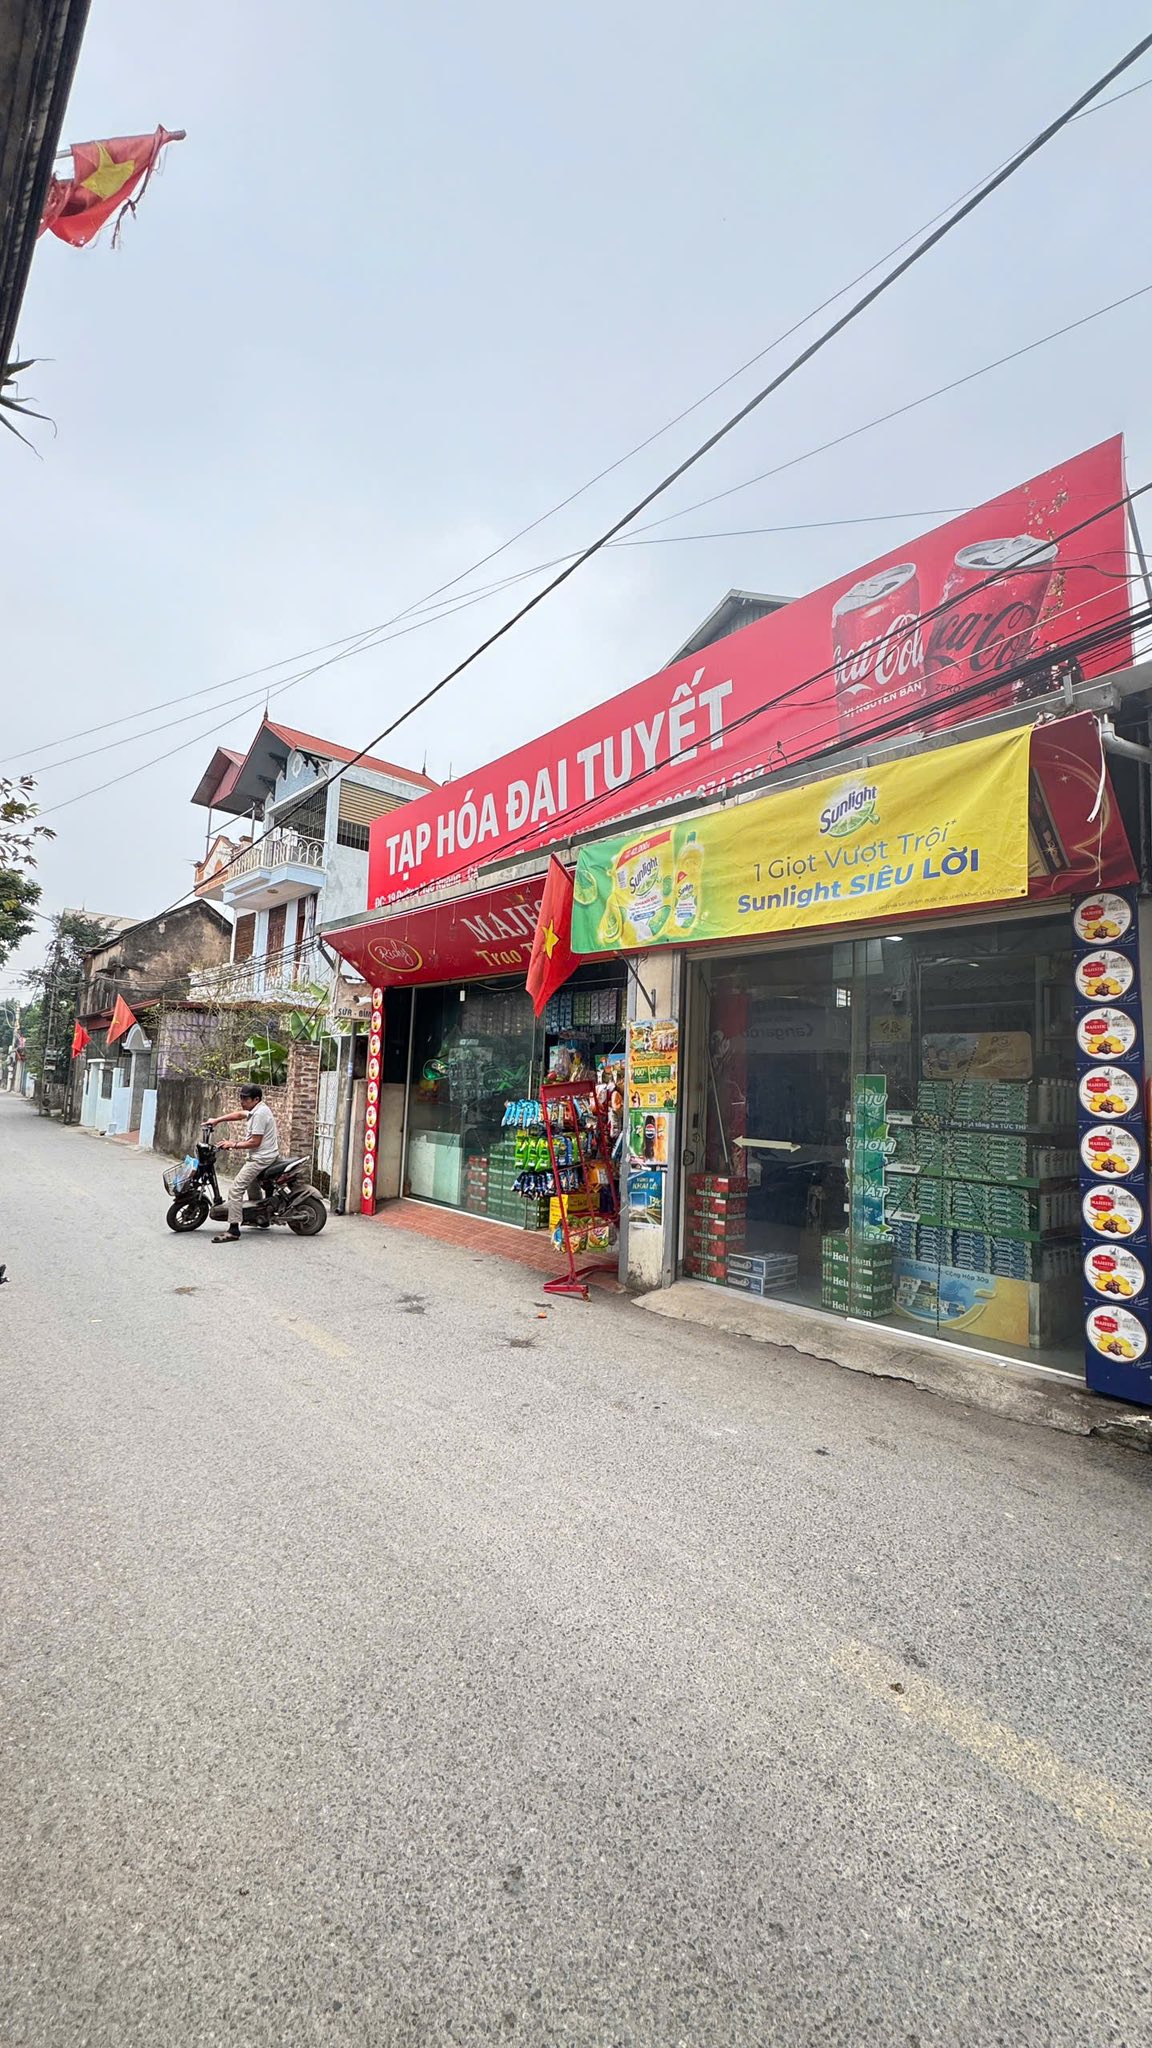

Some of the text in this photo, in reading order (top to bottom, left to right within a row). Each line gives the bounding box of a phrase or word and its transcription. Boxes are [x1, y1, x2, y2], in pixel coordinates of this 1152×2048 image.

[386, 822, 431, 880] TẠP
[437, 788, 499, 858] HÓA
[506, 758, 567, 832] ĐẠI
[577, 666, 733, 801] TUYẾT
[819, 786, 877, 834] Sunlight
[629, 856, 658, 895] Sunlight
[738, 882, 841, 914] Sunlight
[849, 863, 914, 896] SIÊU
[922, 845, 979, 880] LỜI
[754, 863, 761, 882] 1
[768, 854, 816, 880] Giọt
[825, 841, 888, 868] Vượt
[475, 949, 522, 967] Trao
